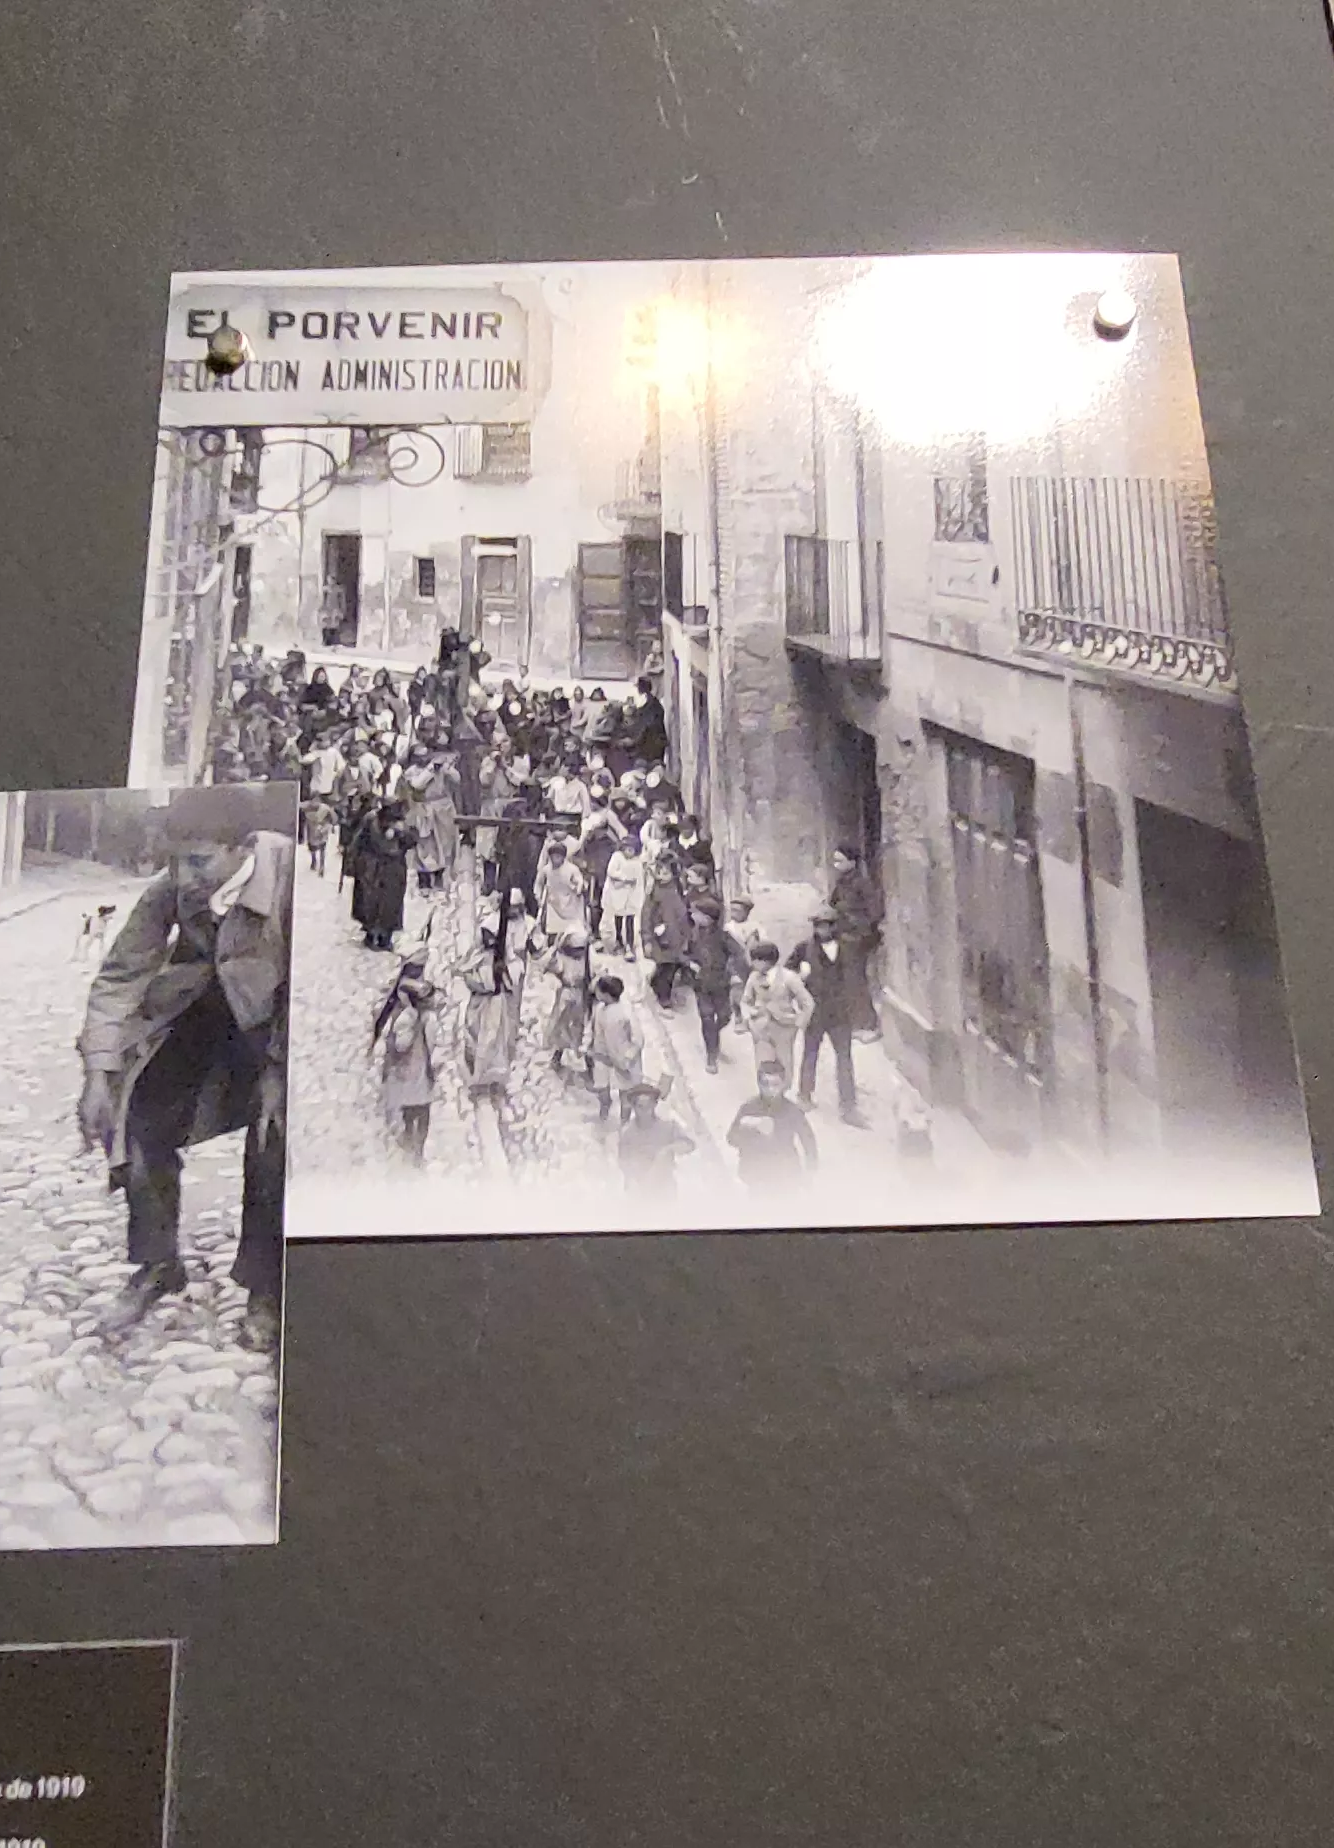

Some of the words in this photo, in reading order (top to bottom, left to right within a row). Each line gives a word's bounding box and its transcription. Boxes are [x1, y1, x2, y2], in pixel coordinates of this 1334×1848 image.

[267, 310, 502, 341] PORVENIR
[321, 358, 521, 391] ADMINISTRACION
[5, 1775, 33, 1800] de
[36, 1773, 86, 1800] 1919
